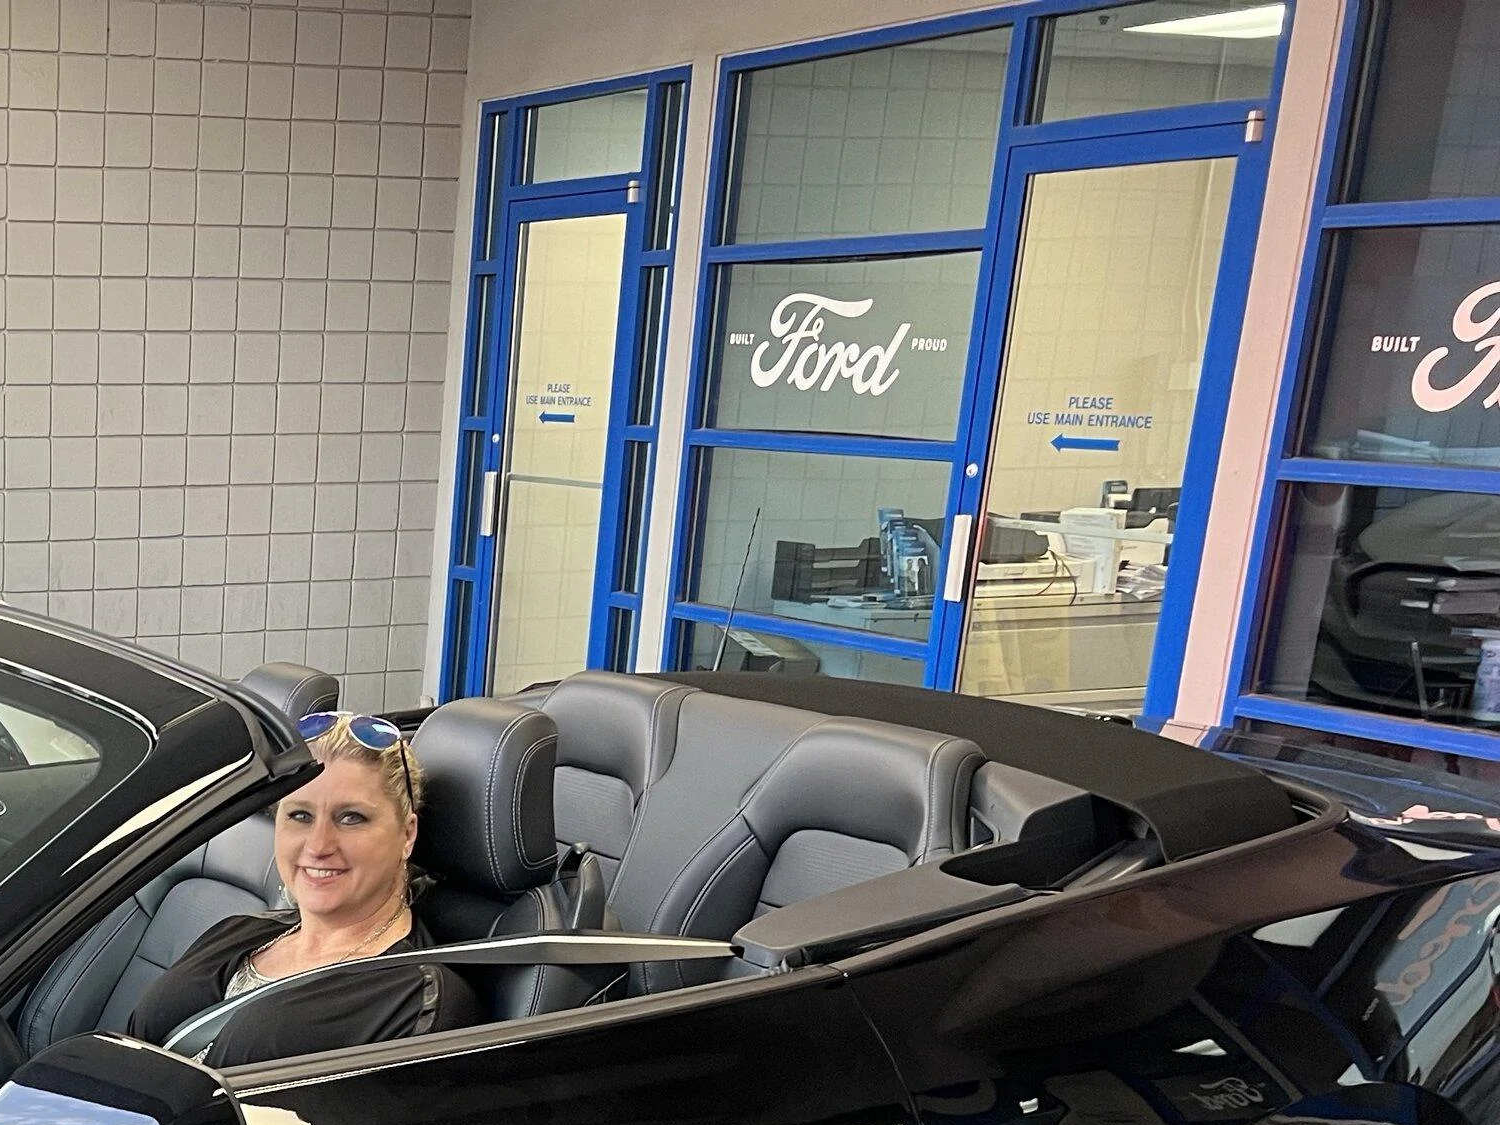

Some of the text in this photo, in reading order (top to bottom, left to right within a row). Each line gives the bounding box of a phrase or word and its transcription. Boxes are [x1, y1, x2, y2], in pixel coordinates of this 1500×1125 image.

[730, 293, 948, 396] BUILT Ford PROUD
[1371, 336, 1420, 352] BUILT
[547, 384, 571, 393] PLEASE
[526, 396, 592, 406] USE MAIN ENTRANCE
[1069, 397, 1113, 409] PLEASE
[1027, 412, 1152, 428] USE MAIN ENTRANCE
